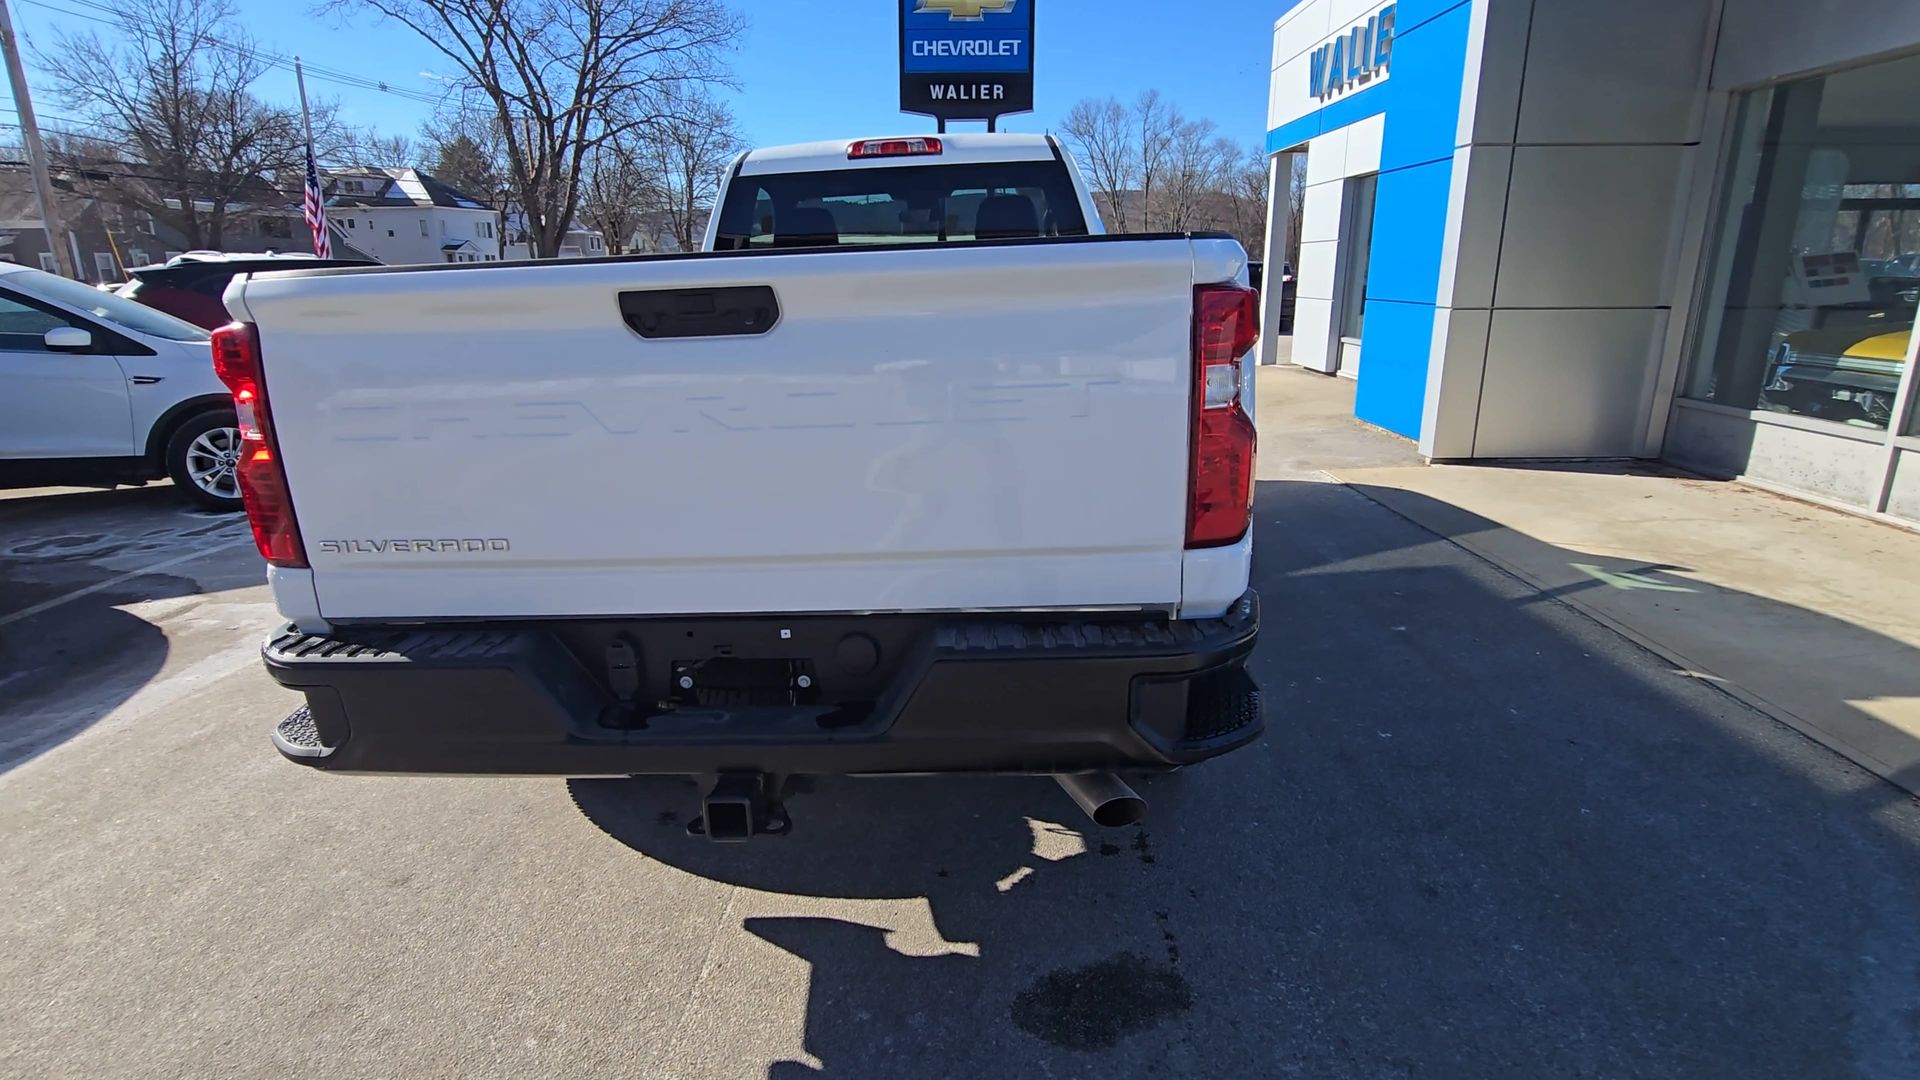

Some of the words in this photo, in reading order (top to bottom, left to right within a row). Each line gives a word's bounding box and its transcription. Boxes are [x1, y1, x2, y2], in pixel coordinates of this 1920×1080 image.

[912, 39, 1022, 56] CHEVROLET
[1310, 3, 1397, 98] WALIE
[929, 84, 1004, 100] WALIER
[319, 538, 510, 553] SILVERADO
